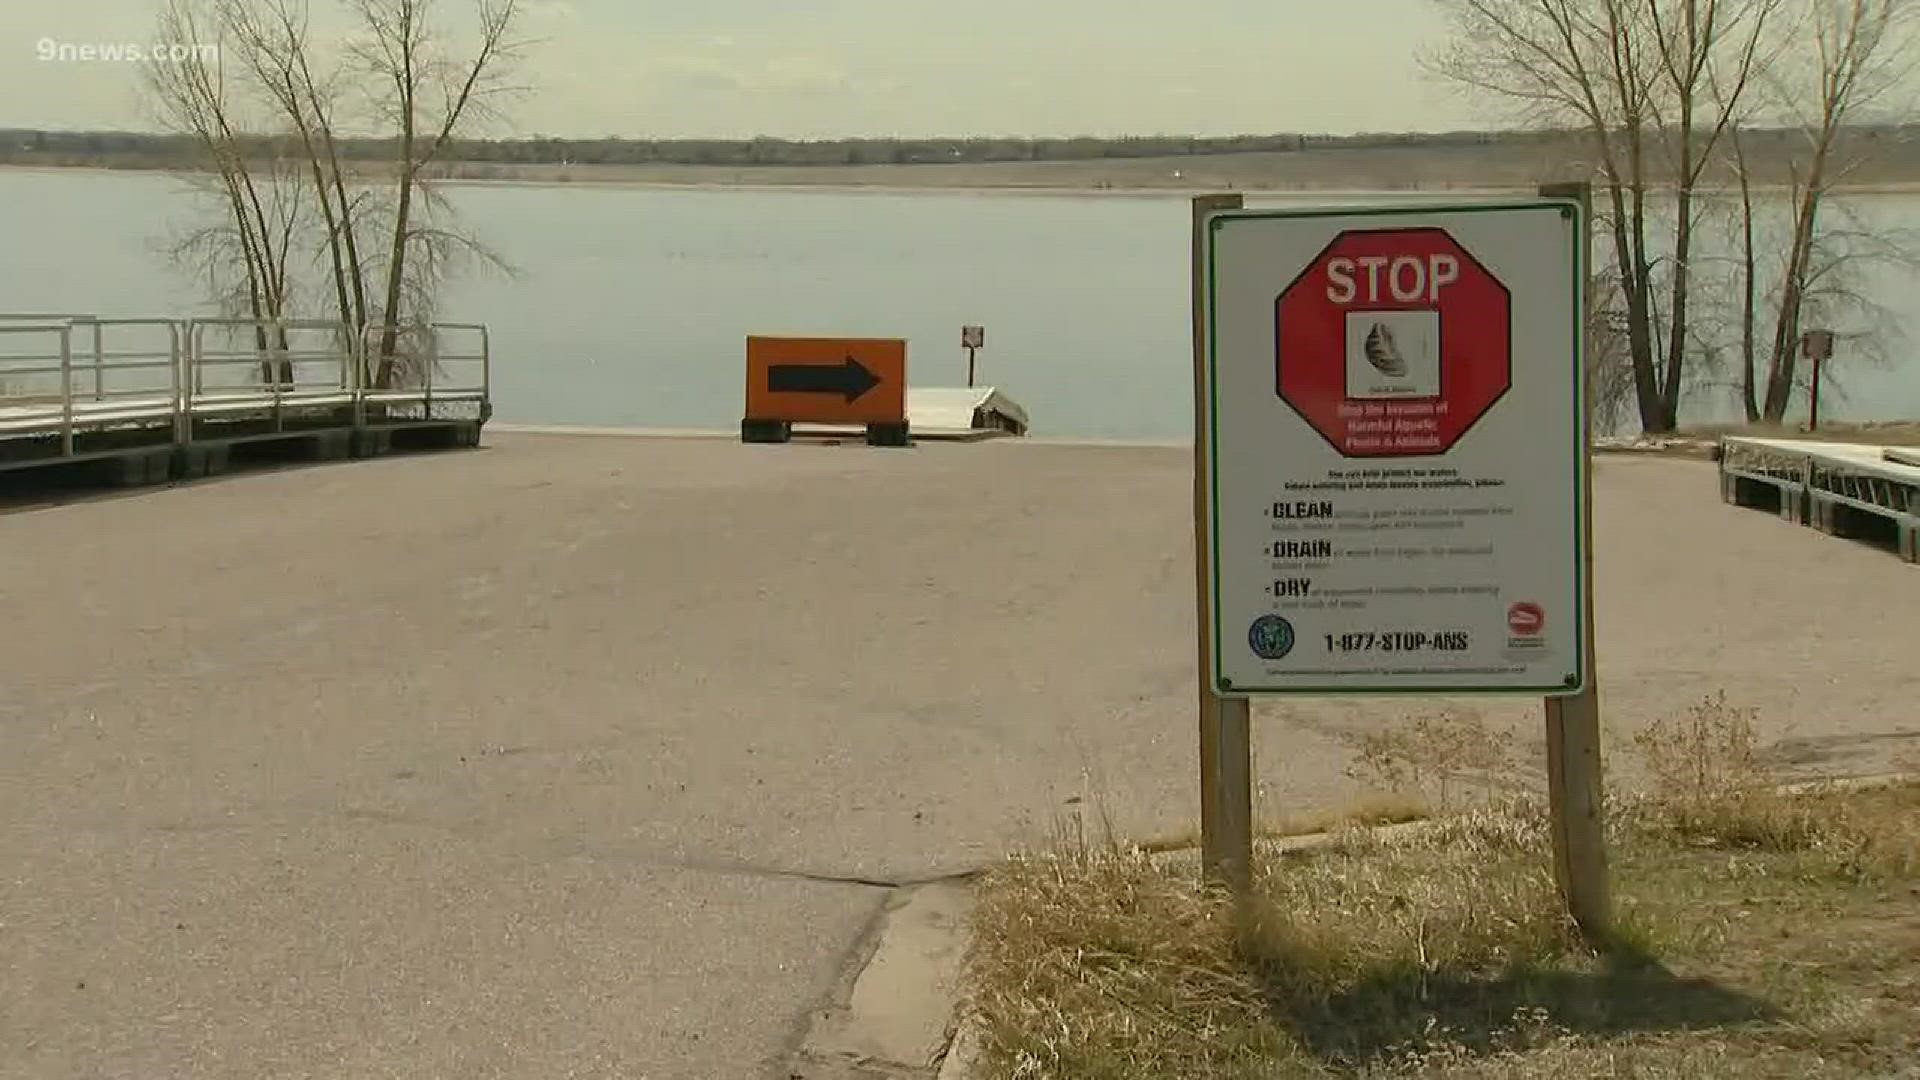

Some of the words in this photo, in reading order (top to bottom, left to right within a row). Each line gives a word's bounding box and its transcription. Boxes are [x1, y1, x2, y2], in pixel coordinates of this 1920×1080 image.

[1327, 254, 1460, 303] STOP
[1347, 418, 1393, 432] Harmful
[1273, 502, 1333, 519] CLEAN
[1273, 540, 1331, 558] DRAIN
[1274, 578, 1311, 597] DRY
[1324, 631, 1469, 652] 1-877-STOP-ANS
